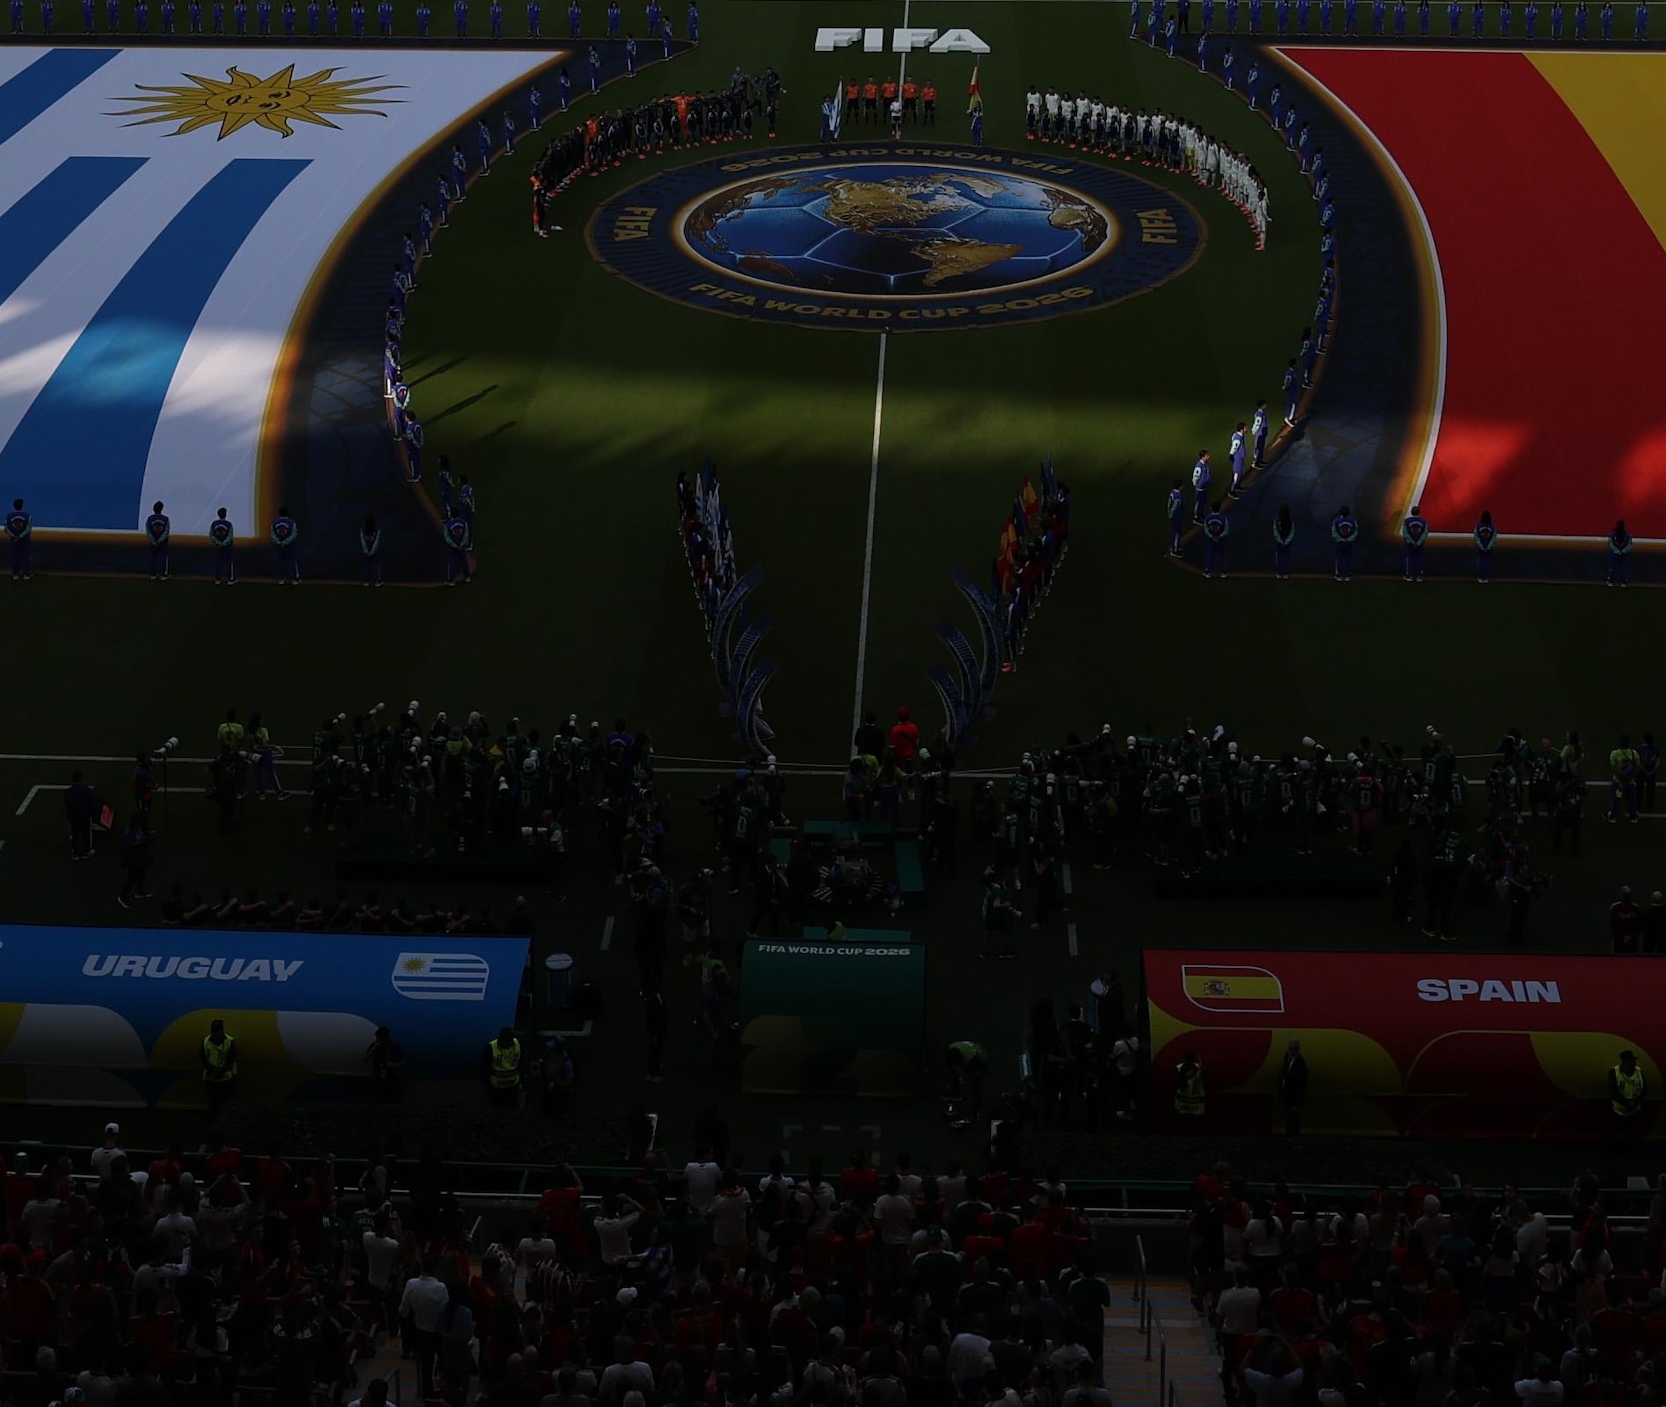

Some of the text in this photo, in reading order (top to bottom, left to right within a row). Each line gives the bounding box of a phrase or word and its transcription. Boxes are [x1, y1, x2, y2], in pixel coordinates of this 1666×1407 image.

[815, 28, 990, 53] FIFA
[721, 148, 1074, 175] FIFA WORLD CUP 2026
[614, 206, 658, 241] FIFA
[1136, 208, 1178, 244] FIFA
[688, 283, 1094, 319] FIFA WORLD CUP 2026
[759, 945, 910, 956] FIFA WORLD CUP 2026
[82, 954, 304, 981] URUGUAY
[1416, 979, 1561, 1003] SPAIN
